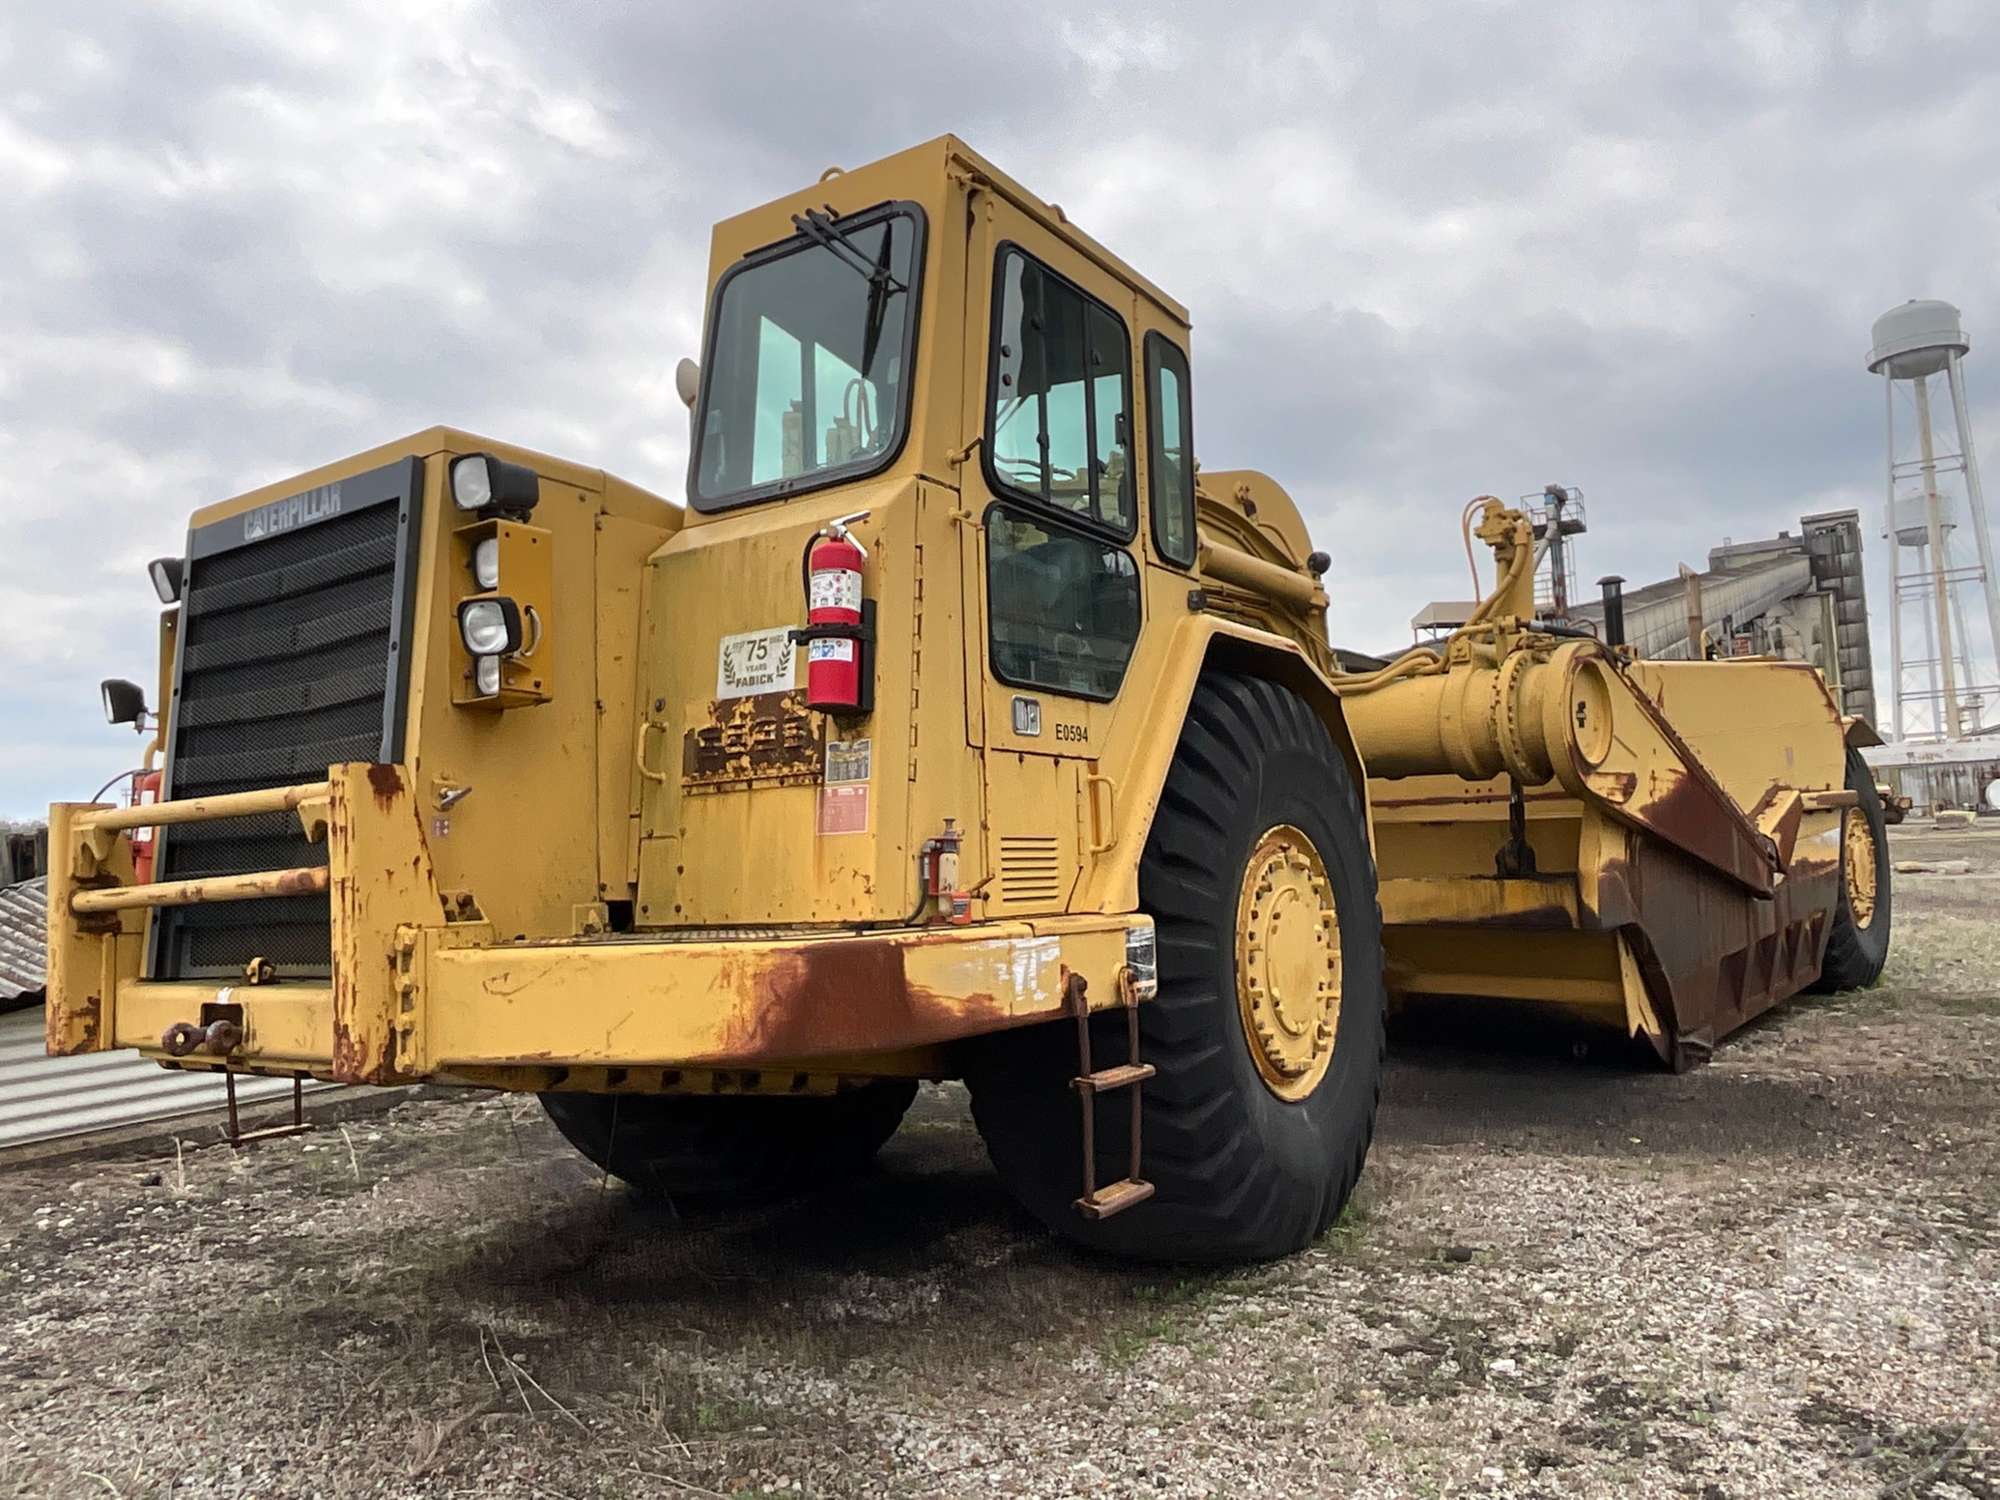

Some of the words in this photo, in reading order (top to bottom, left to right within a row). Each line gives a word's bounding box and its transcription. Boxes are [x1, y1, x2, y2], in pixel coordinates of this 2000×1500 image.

[244, 482, 342, 541] CATERPILLAR
[747, 638, 767, 662] 75
[736, 673, 775, 688] FABICK
[1055, 723, 1088, 742] E0594
